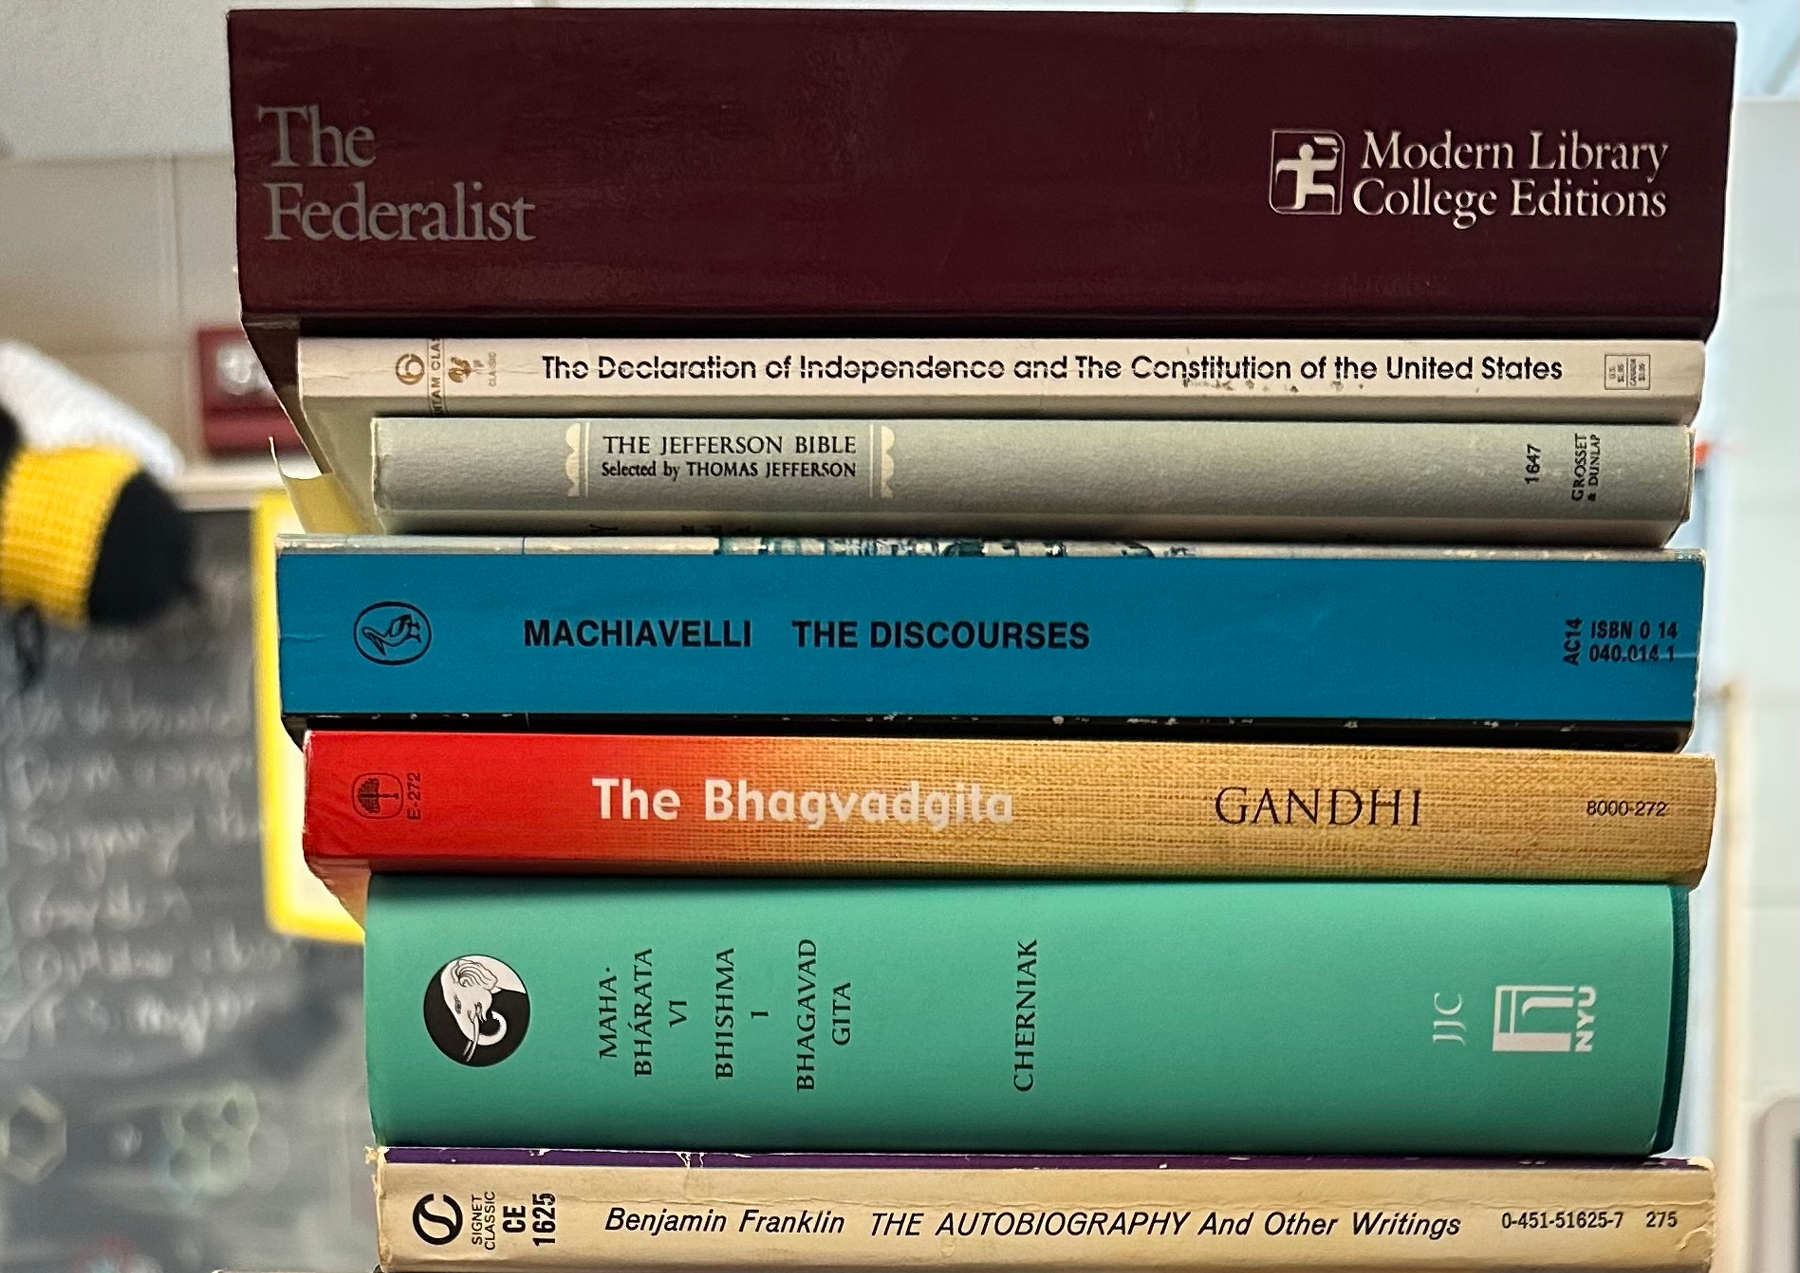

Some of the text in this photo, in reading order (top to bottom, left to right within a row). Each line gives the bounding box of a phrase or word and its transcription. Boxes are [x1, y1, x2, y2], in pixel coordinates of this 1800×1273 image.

[258, 105, 376, 167] The
[1362, 130, 1668, 182] Modern Library
[264, 182, 536, 241] Federalist
[1353, 178, 1666, 229] College Editions
[542, 356, 1562, 383] The Declaration of Independence and The Constitution of the United States
[602, 460, 855, 481] Selected by THOMAS JEFFERSON
[603, 436, 856, 455] THE JEFFERSON BIBLE
[1525, 444, 1540, 484] 1647
[1572, 434, 1586, 501] GROSSET
[1588, 435, 1600, 486] DUNLAP
[525, 620, 1089, 649] MACHIAVELLI THE DISCOURSES
[1563, 618, 1582, 665] AC14
[407, 773, 421, 820] E-272
[592, 773, 1015, 832] The Bhagvadgita
[1215, 787, 1421, 826] GANDHI
[1586, 800, 1669, 816] 8000-272
[715, 949, 734, 1079] BHISHMA
[797, 940, 816, 1091] BHAGAVAD
[832, 983, 850, 1045] GITA
[1014, 940, 1037, 1092] CHERNIAK
[1574, 986, 1596, 1051] NYU
[471, 1194, 482, 1251] SIGNET
[484, 1192, 495, 1250] CLASSIC
[503, 1206, 525, 1232] CE
[532, 1194, 555, 1246] 1625
[605, 1208, 1460, 1240] Benjamin Franklin THE AUTOBIOGRAPHY And Other Writings
[1502, 1211, 1677, 1229] 0-451-51625-7 275
